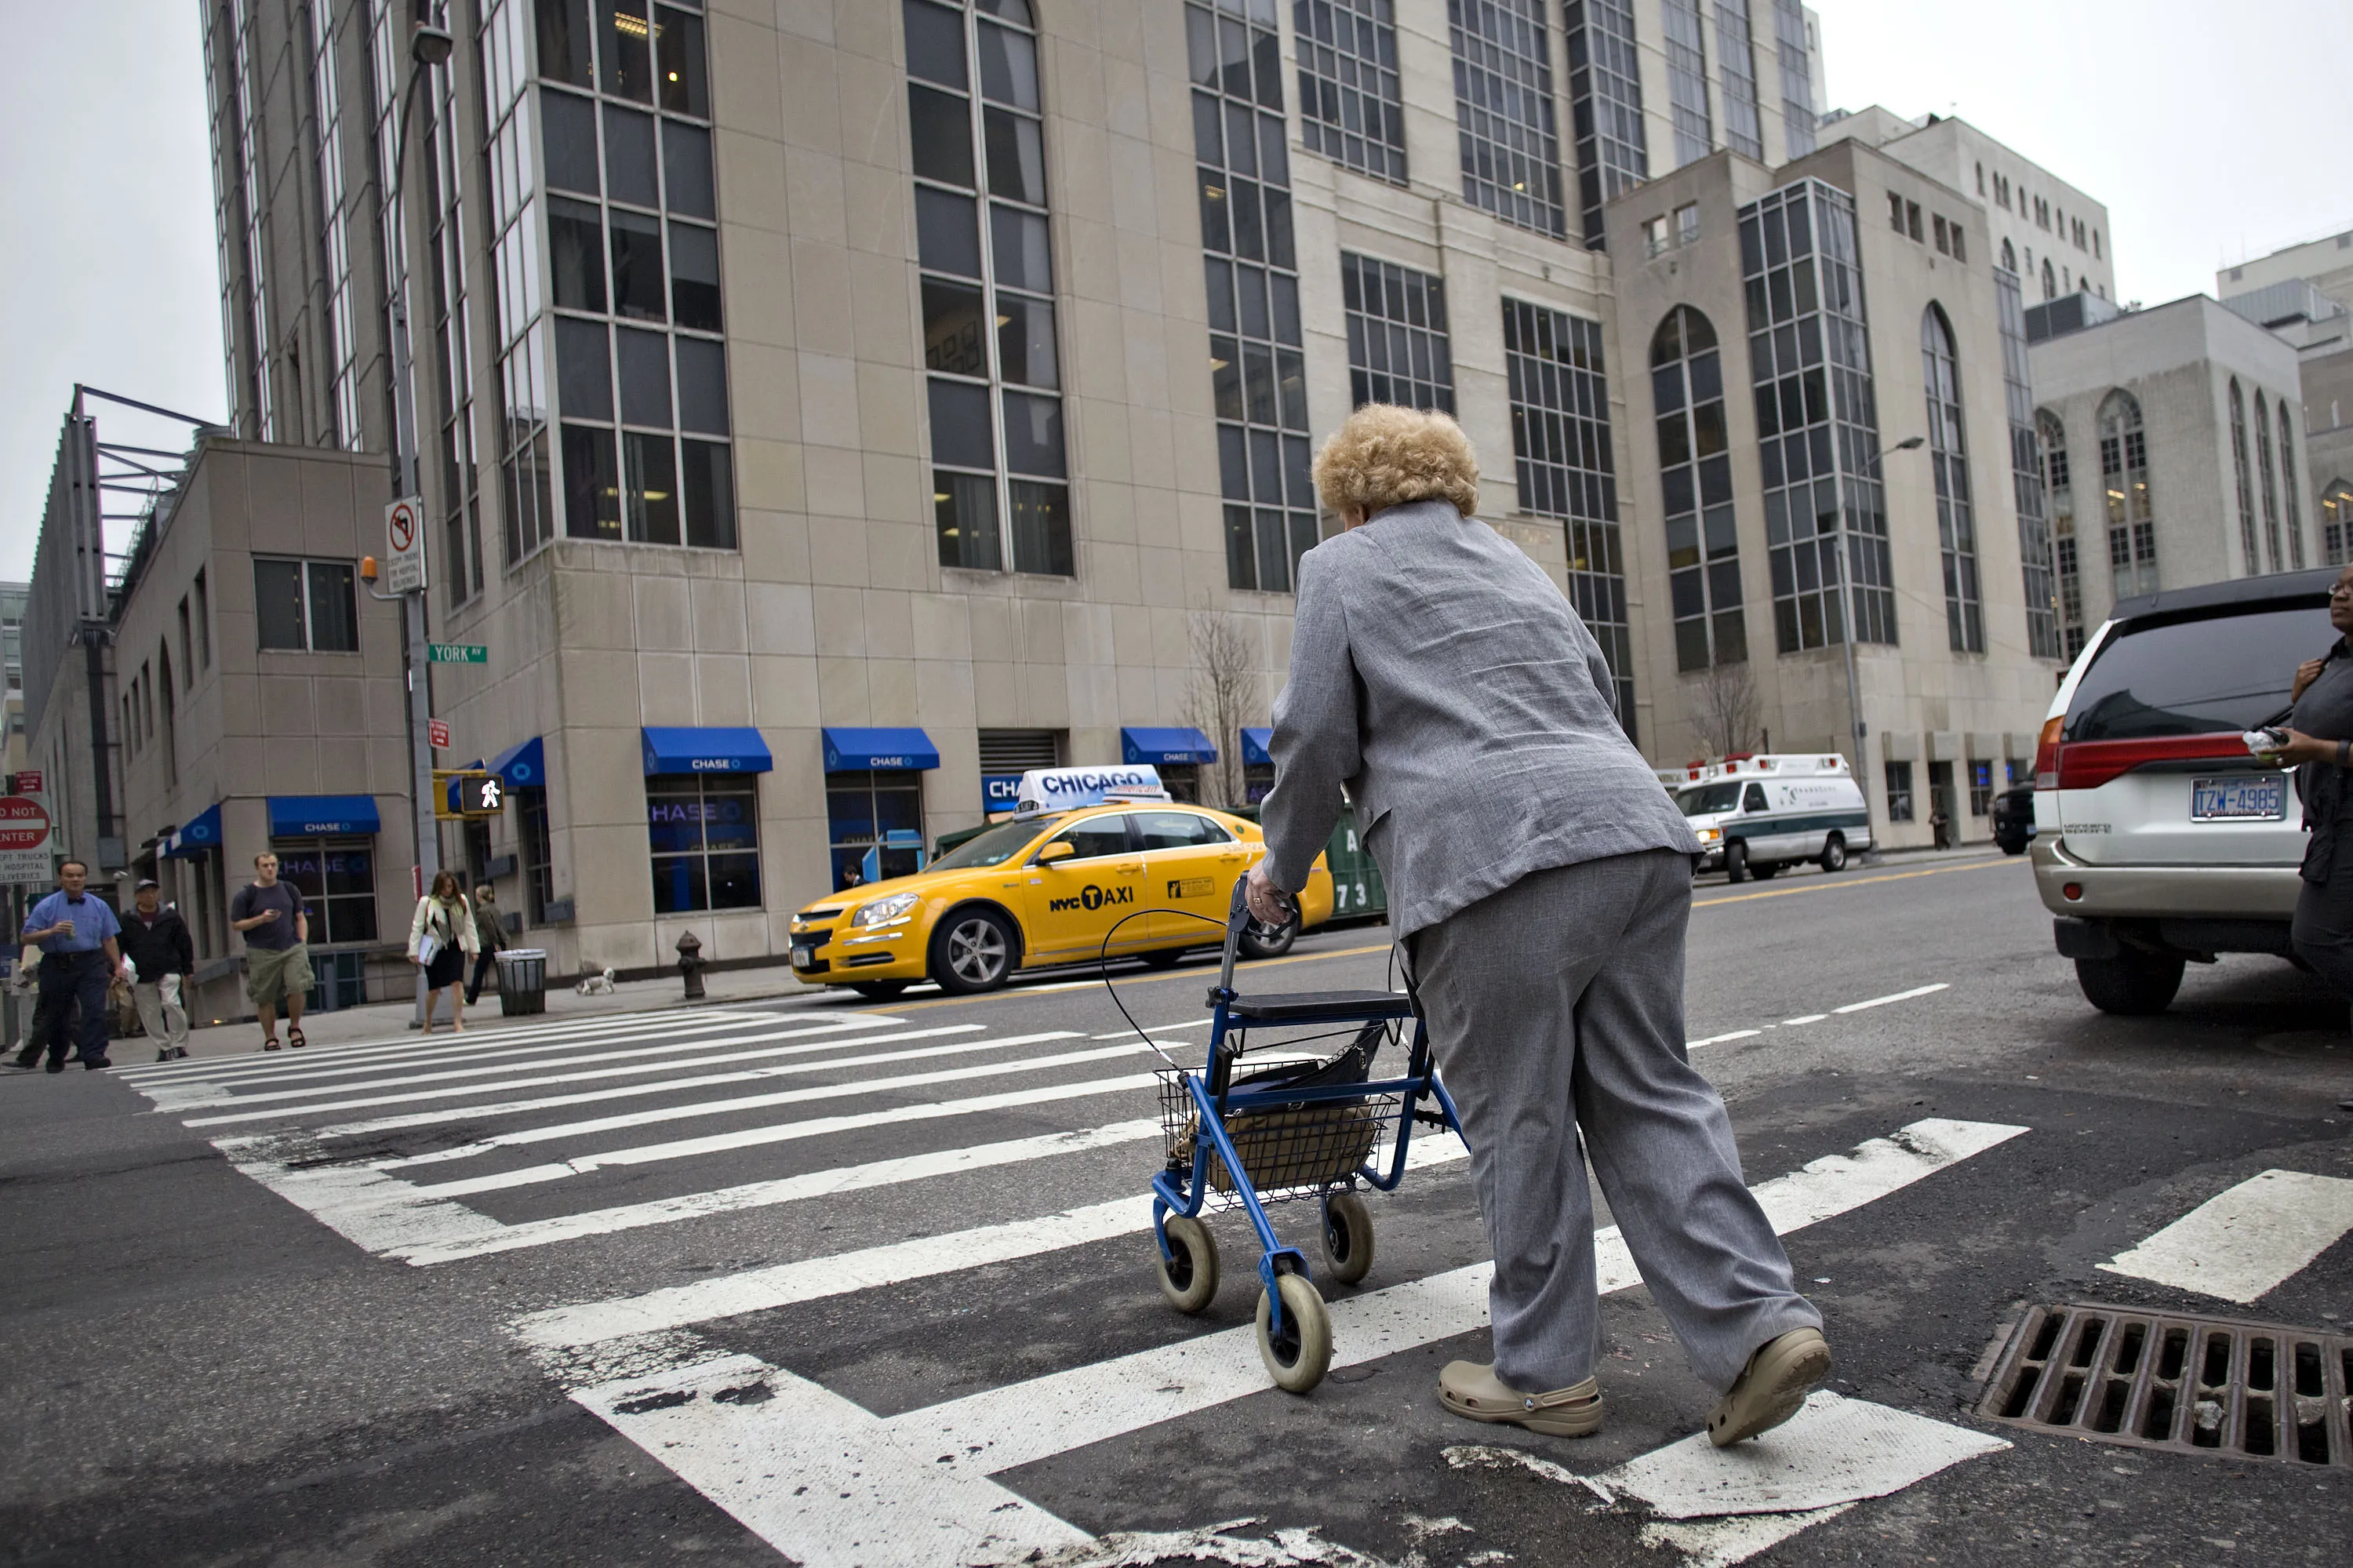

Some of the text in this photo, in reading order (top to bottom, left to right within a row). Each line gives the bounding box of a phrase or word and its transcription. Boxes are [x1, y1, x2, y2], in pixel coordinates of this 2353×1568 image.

[435, 646, 482, 662] YORK AV
[870, 756, 903, 766] CHASE
[1163, 752, 1188, 761] CHASE
[692, 759, 729, 769] CHASE
[1042, 772, 1143, 794] CHICAGO
[2197, 788, 2279, 811] TZW-4985
[11, 807, 37, 817] NOT
[647, 802, 717, 822] HASE
[304, 823, 340, 832] CHASE
[0, 831, 35, 842] NTER
[18, 852, 49, 860] TRUCKS
[5, 862, 45, 871] HOSPITAL
[1049, 884, 1133, 911] NYC TAXI
